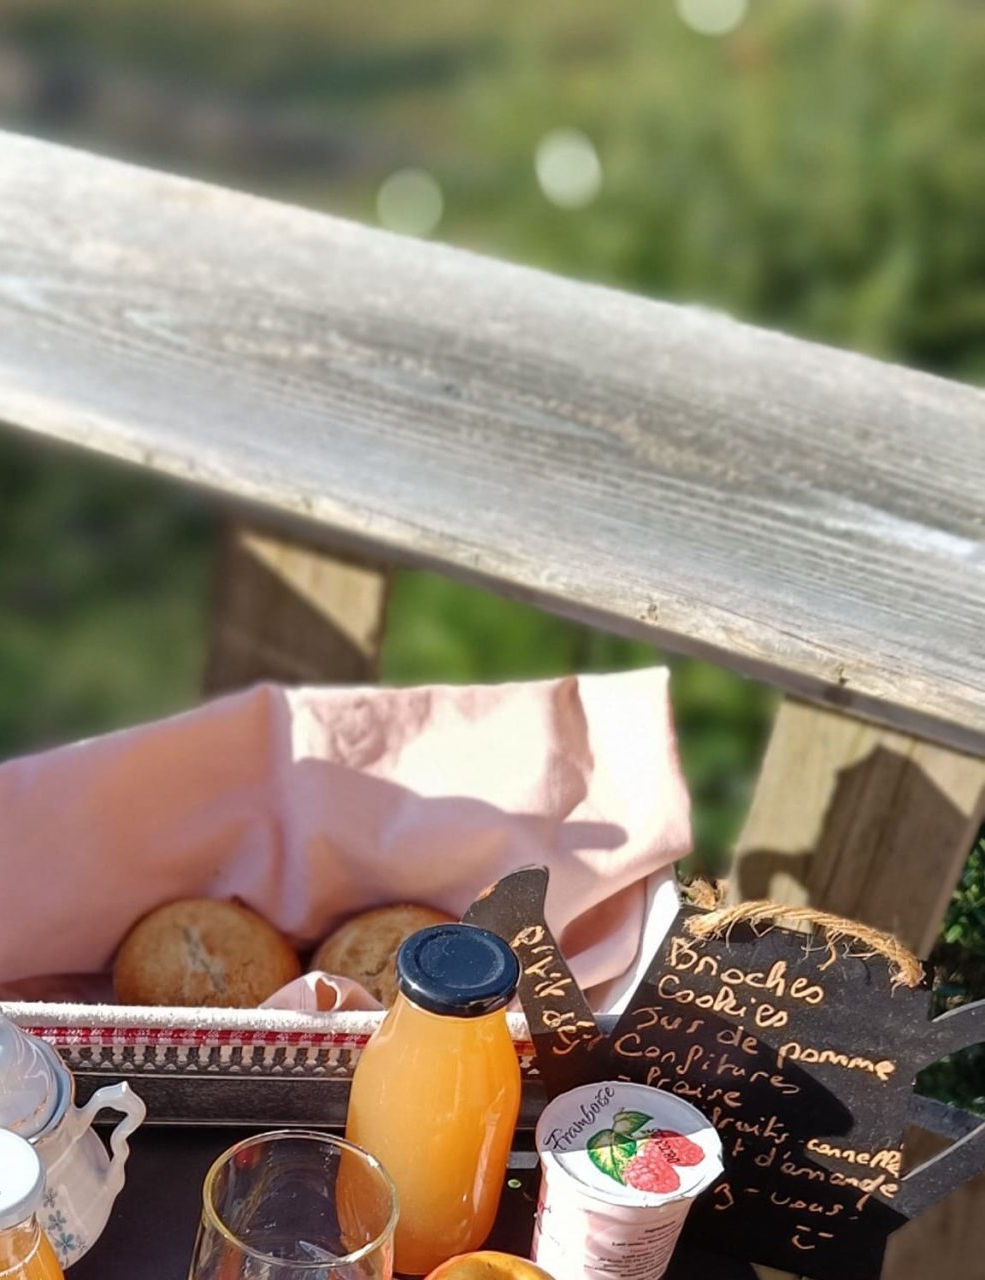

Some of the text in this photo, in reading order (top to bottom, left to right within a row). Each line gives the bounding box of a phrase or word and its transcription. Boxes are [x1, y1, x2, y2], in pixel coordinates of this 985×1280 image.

[658, 974, 789, 1028] Cookies
[668, 936, 825, 1004] Brioches
[614, 1032, 801, 1095] Confitures
[631, 1006, 897, 1081] Jus de pomme
[542, 1086, 615, 1151] Framboise
